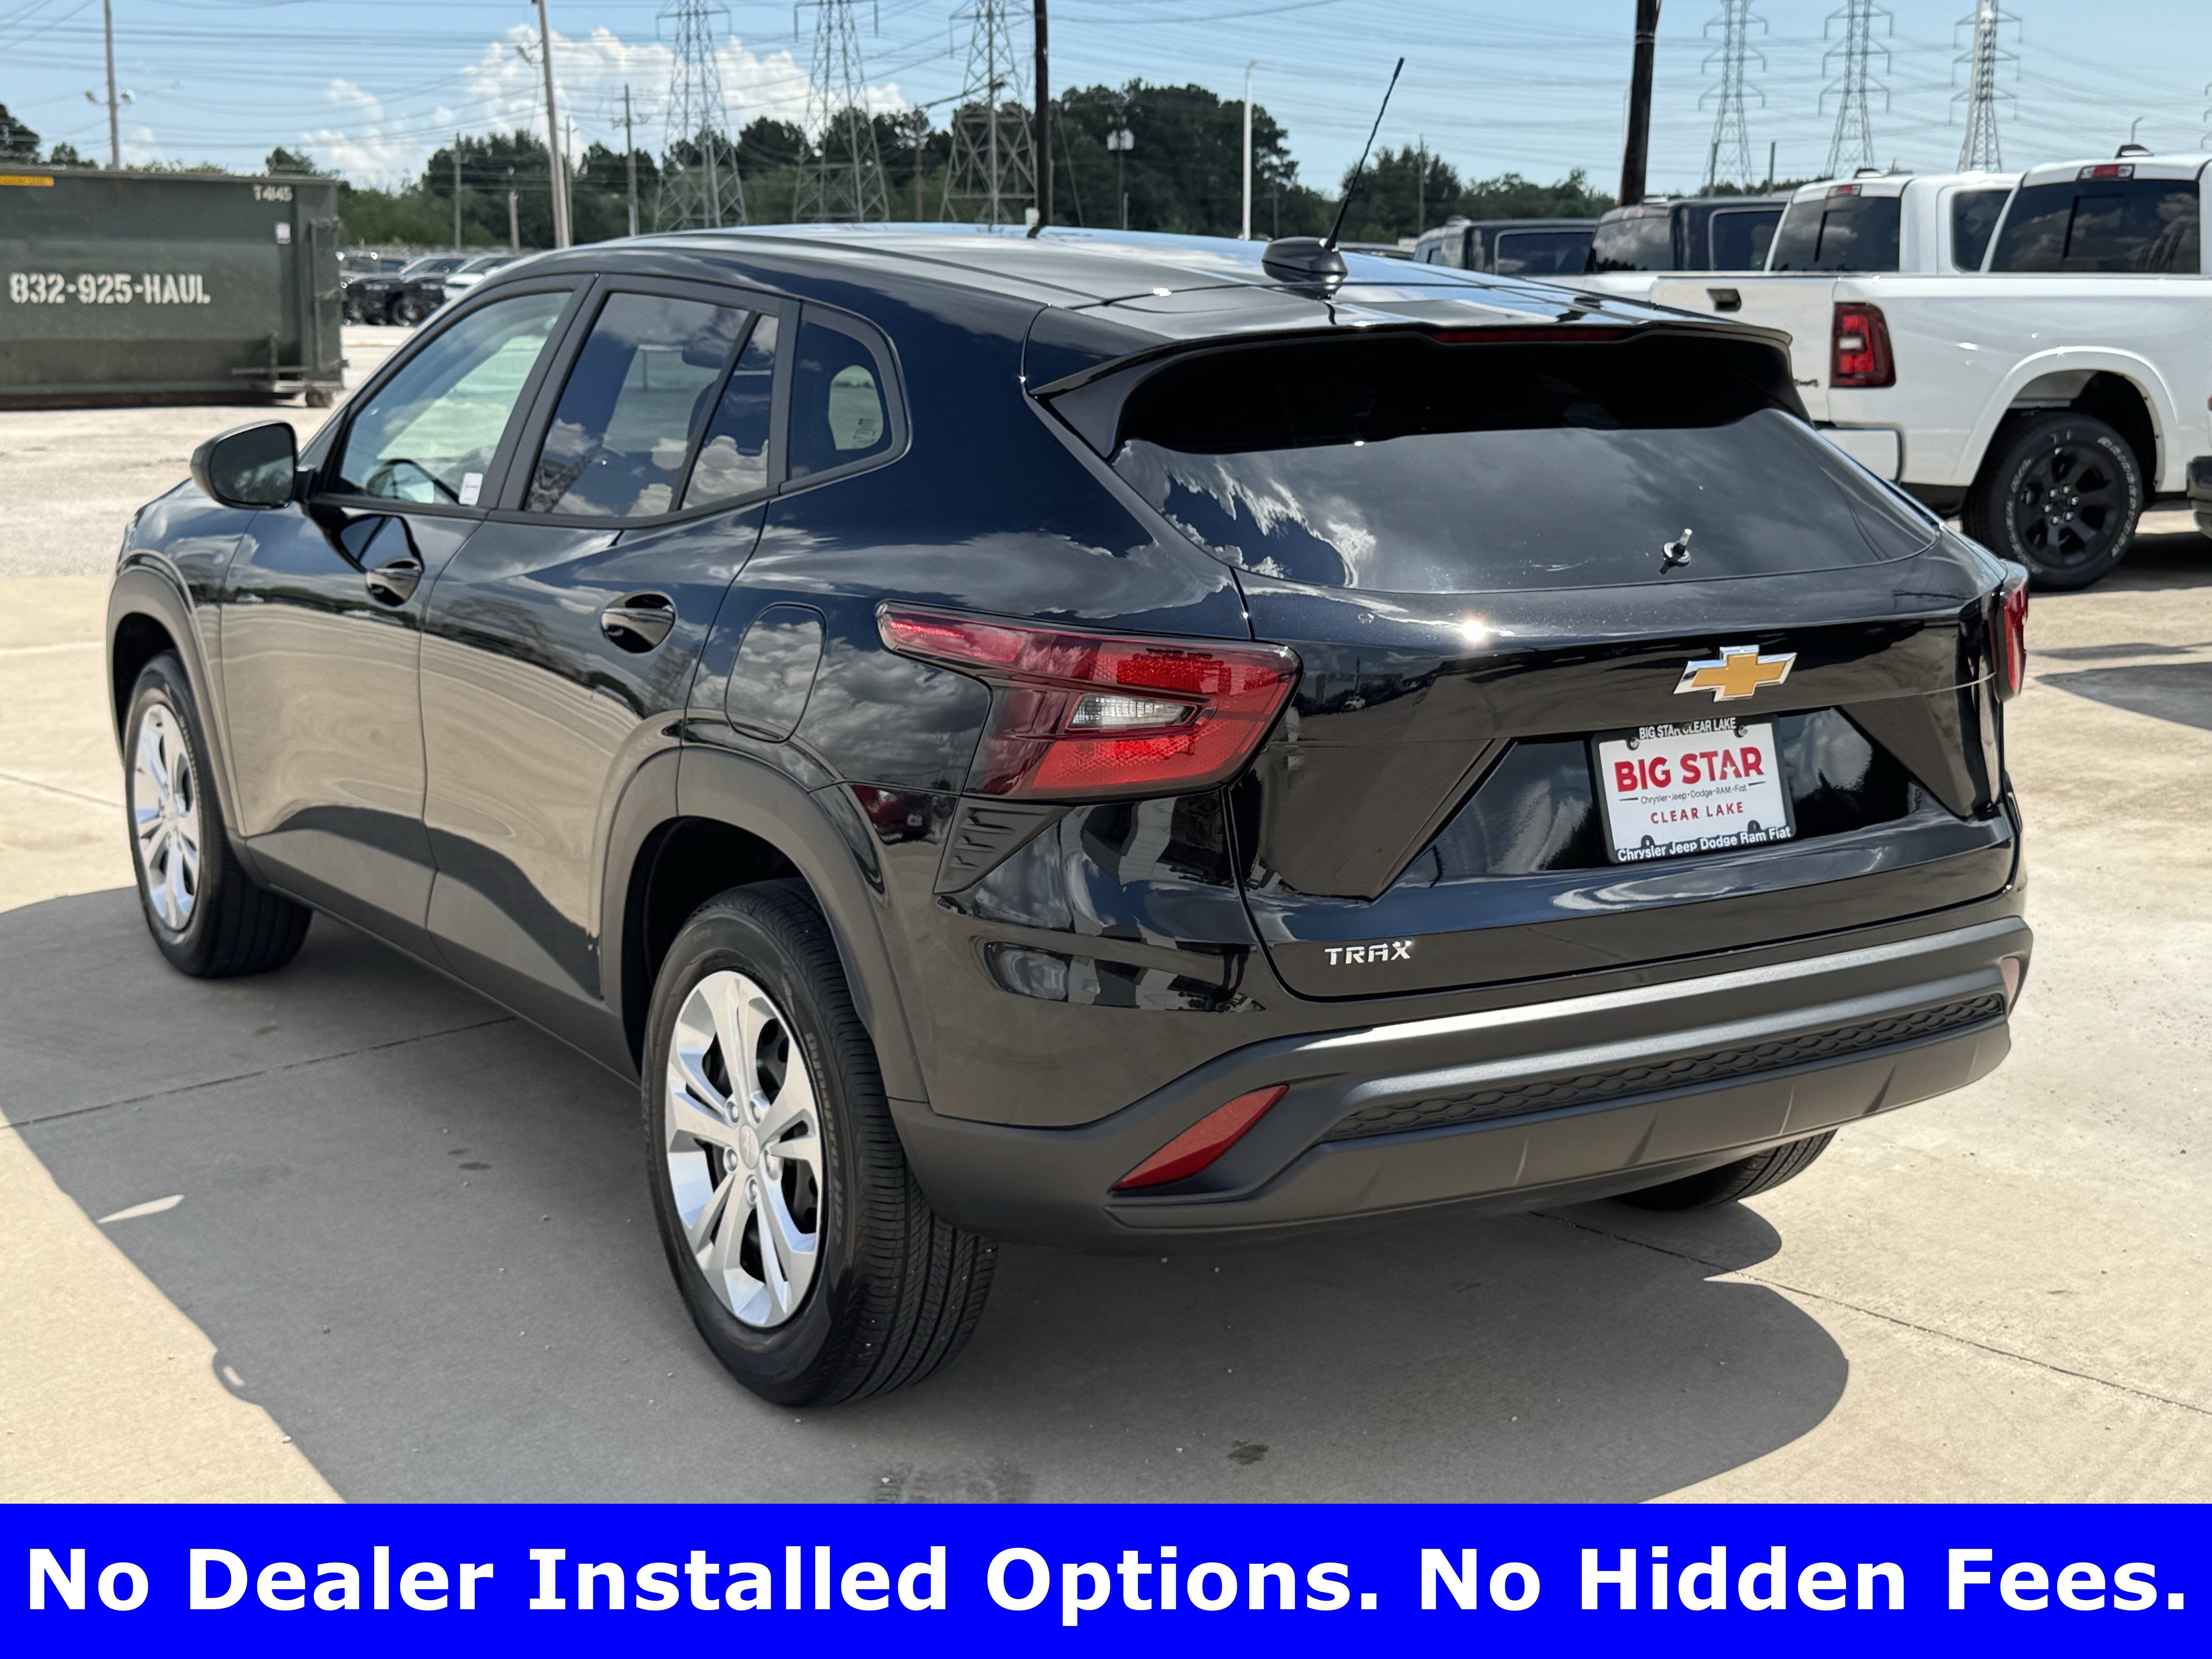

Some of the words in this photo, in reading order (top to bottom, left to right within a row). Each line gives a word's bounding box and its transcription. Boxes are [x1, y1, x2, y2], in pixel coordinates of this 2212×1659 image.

[9, 273, 211, 304] 832-925-HAUL
[1639, 726, 1656, 740] BIG
[1713, 717, 1736, 731] LAKE
[1614, 757, 1671, 792] BIG
[1680, 747, 1765, 784] STAR
[1650, 807, 1699, 824] CLEAR
[1706, 802, 1743, 817] LAKE
[1618, 845, 1666, 861] Chrysler
[1669, 842, 1697, 855] Jeep
[1700, 835, 1738, 850] Dodge
[1740, 831, 1766, 844] Ram
[1769, 826, 1791, 840] Fiat
[1325, 940, 1412, 965] TRAX
